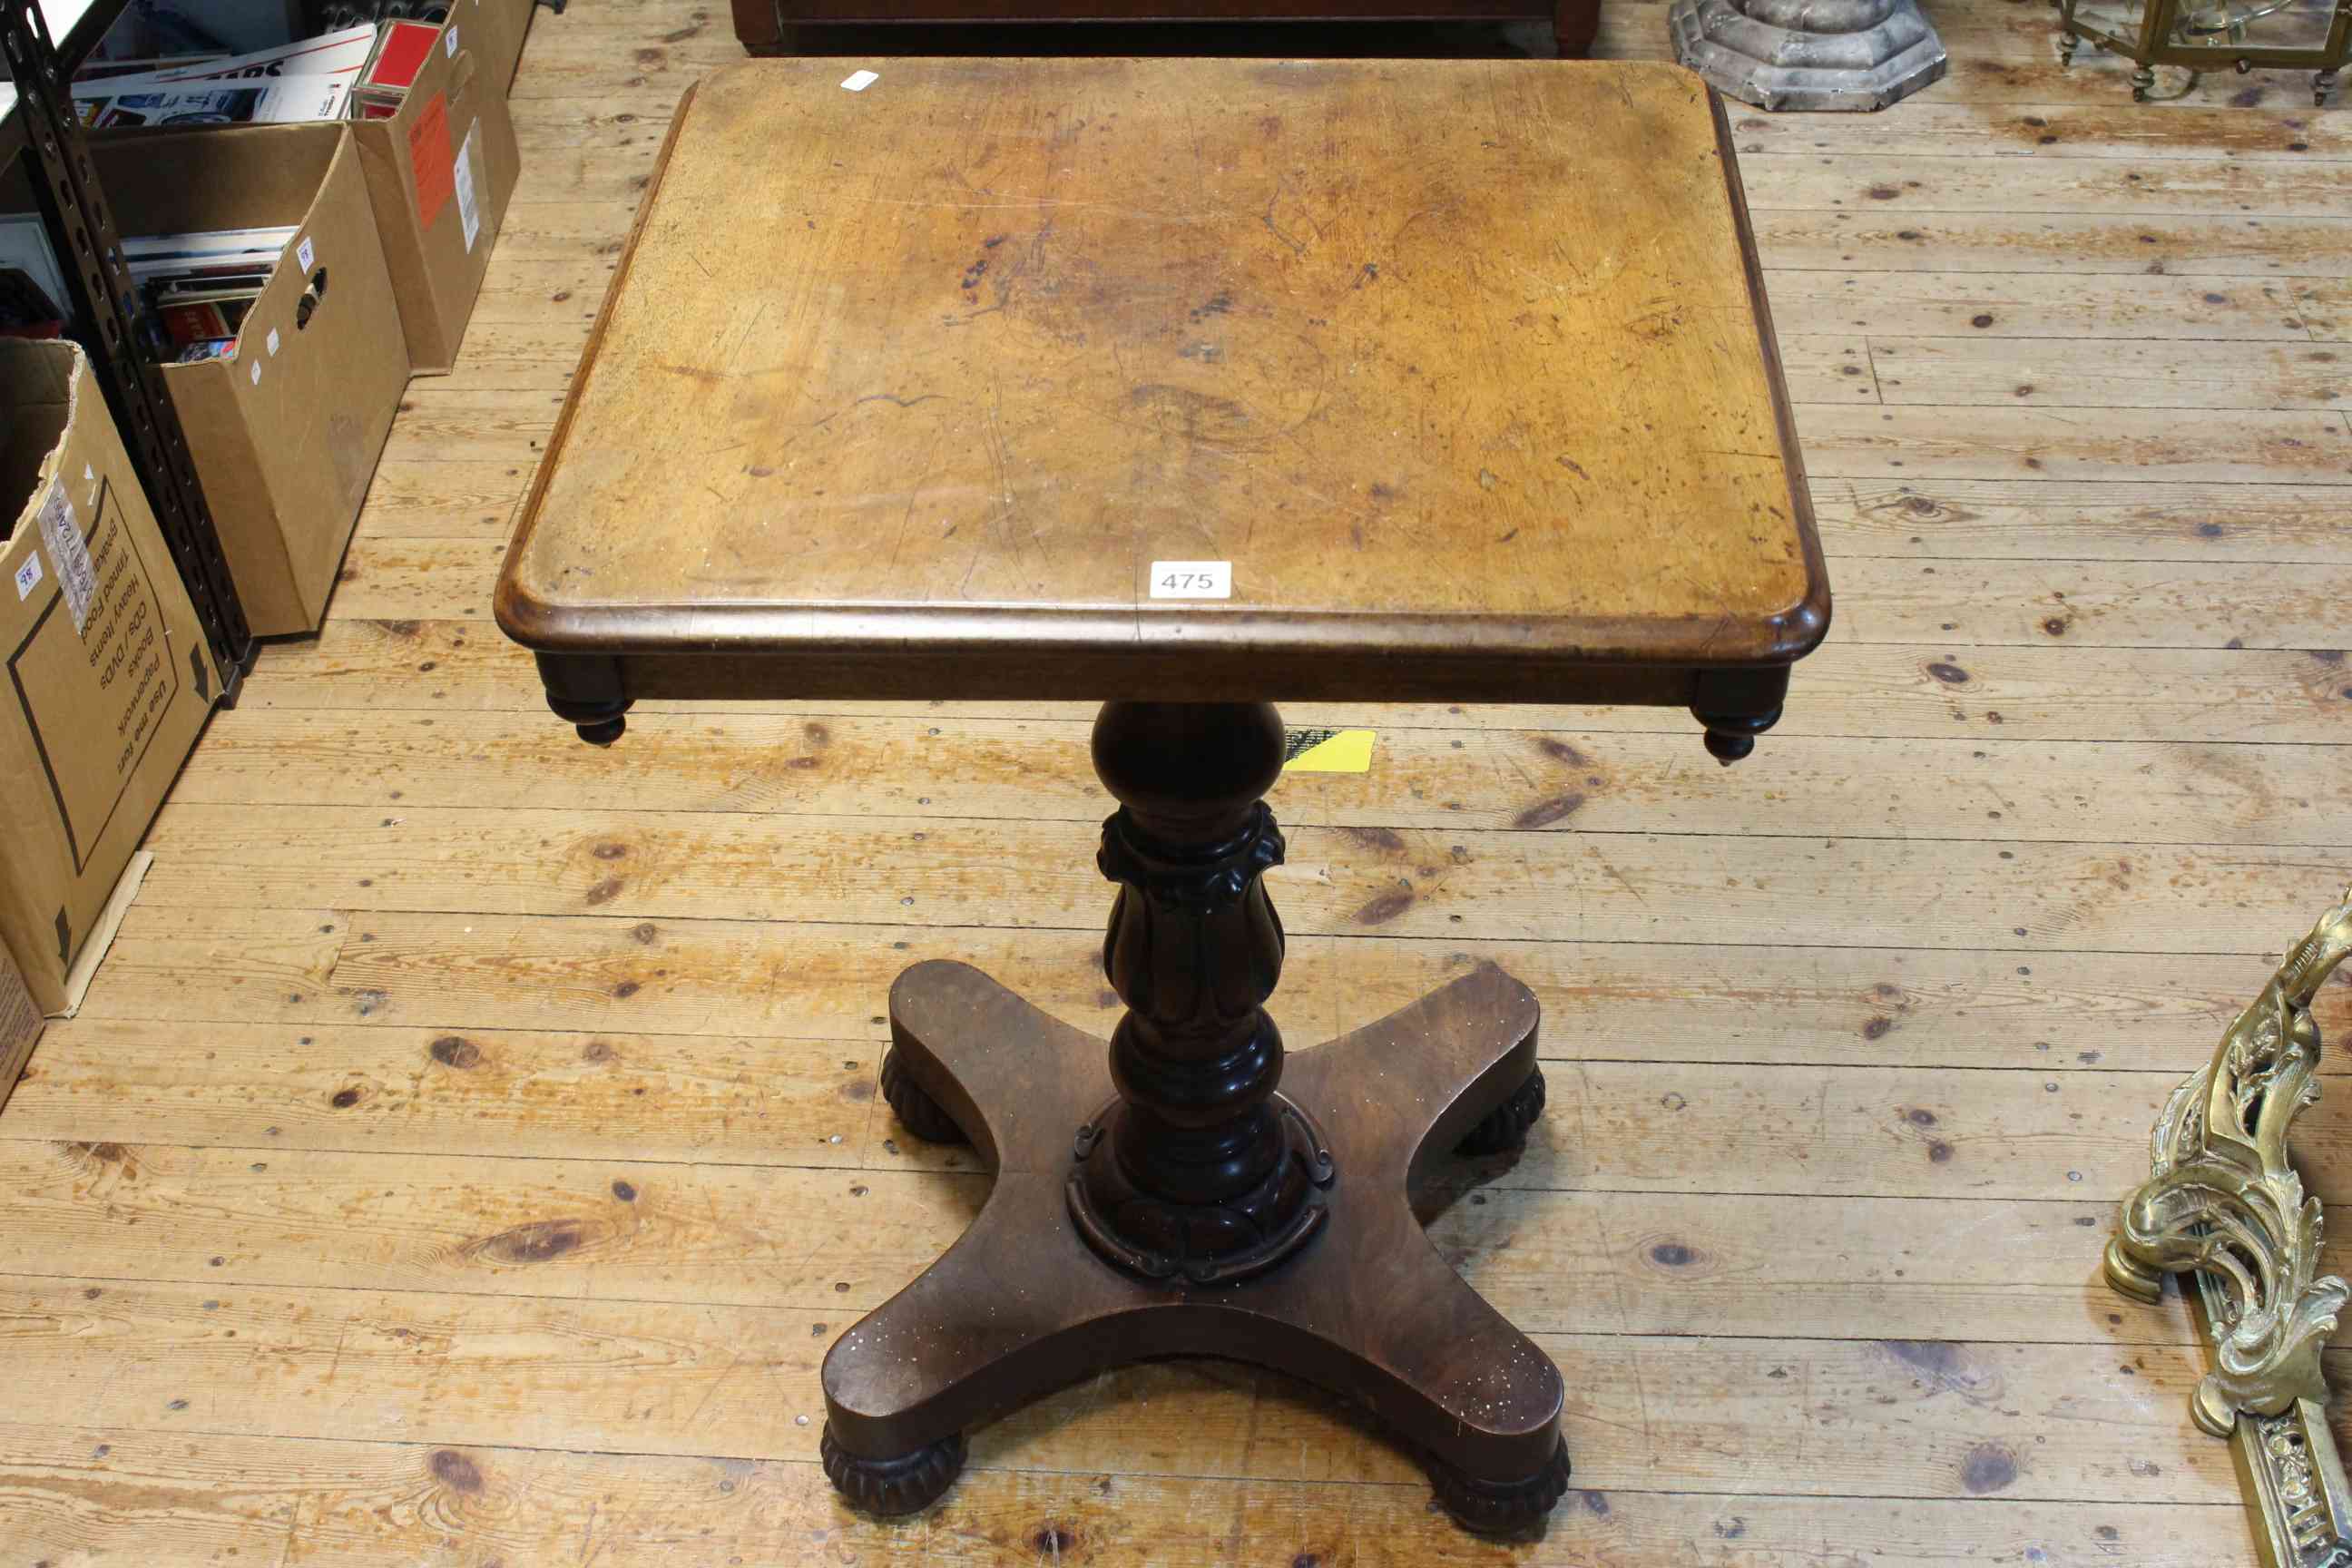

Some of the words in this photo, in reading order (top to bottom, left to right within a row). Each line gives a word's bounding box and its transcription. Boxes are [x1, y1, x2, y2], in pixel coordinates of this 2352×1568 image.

[103, 546, 129, 599] Tinned
[1161, 573, 1213, 589] 475
[80, 595, 104, 647] Food
[113, 571, 140, 626] Heavy
[129, 599, 148, 637] CDs
[90, 622, 116, 668] Items
[100, 643, 125, 691] DVDs
[127, 626, 154, 680] Books
[116, 652, 161, 738] Paperwork
[148, 679, 167, 713] Use
[133, 712, 149, 742] me
